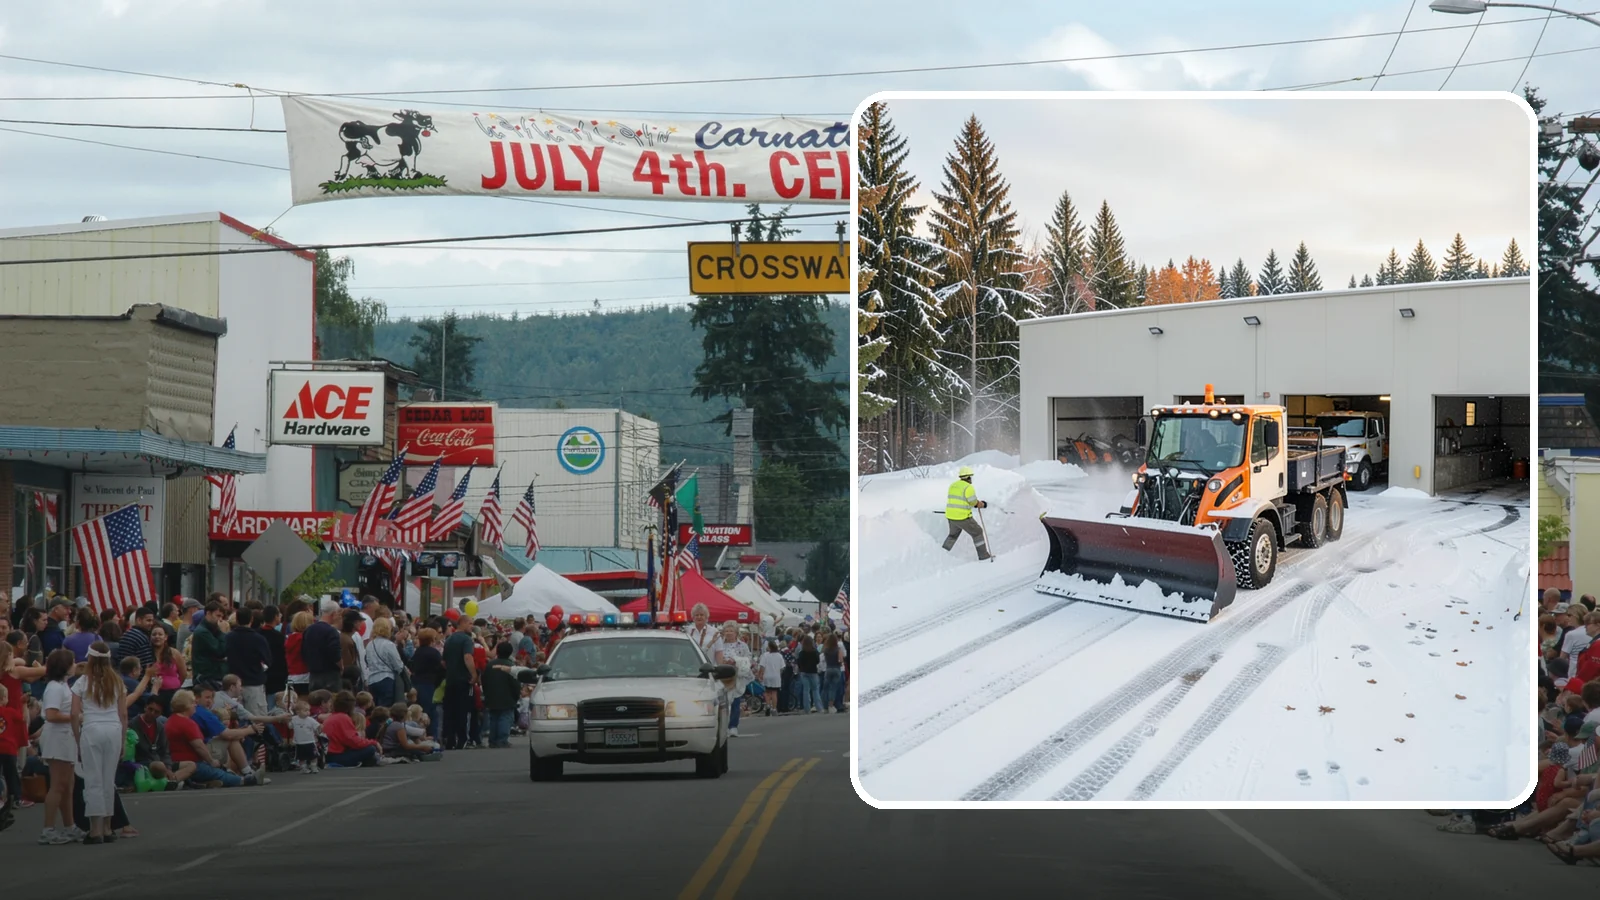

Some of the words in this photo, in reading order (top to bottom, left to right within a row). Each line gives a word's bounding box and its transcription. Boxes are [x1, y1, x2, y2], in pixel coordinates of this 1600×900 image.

[481, 141, 604, 192] JULY
[632, 150, 747, 198] 4th.
[697, 254, 850, 280] CROSSWA
[283, 380, 373, 420] ACE
[406, 409, 452, 422] CEDAR
[283, 421, 371, 437] Hardware
[353, 467, 386, 480] Simpl
[96, 485, 124, 494] Vincent
[126, 486, 136, 495] de
[138, 486, 155, 495] Paul
[688, 526, 741, 535] CRNATION
[700, 535, 730, 543] GLASS
